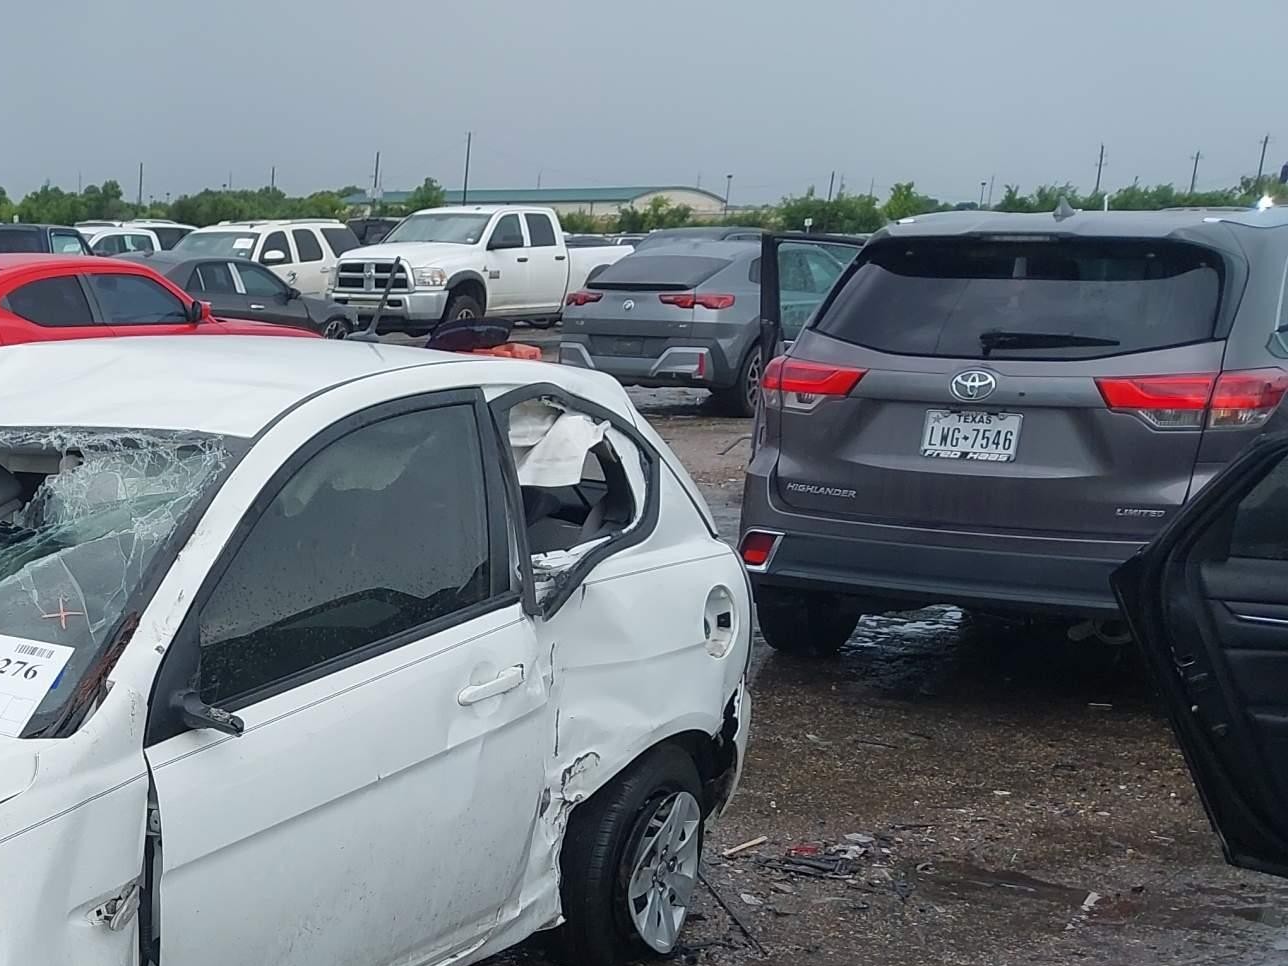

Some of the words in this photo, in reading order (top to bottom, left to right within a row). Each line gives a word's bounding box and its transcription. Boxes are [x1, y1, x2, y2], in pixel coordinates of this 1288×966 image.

[957, 415, 992, 424] TEXAS
[786, 482, 857, 499] HIGHLANDER
[1116, 508, 1166, 518] LIMITED
